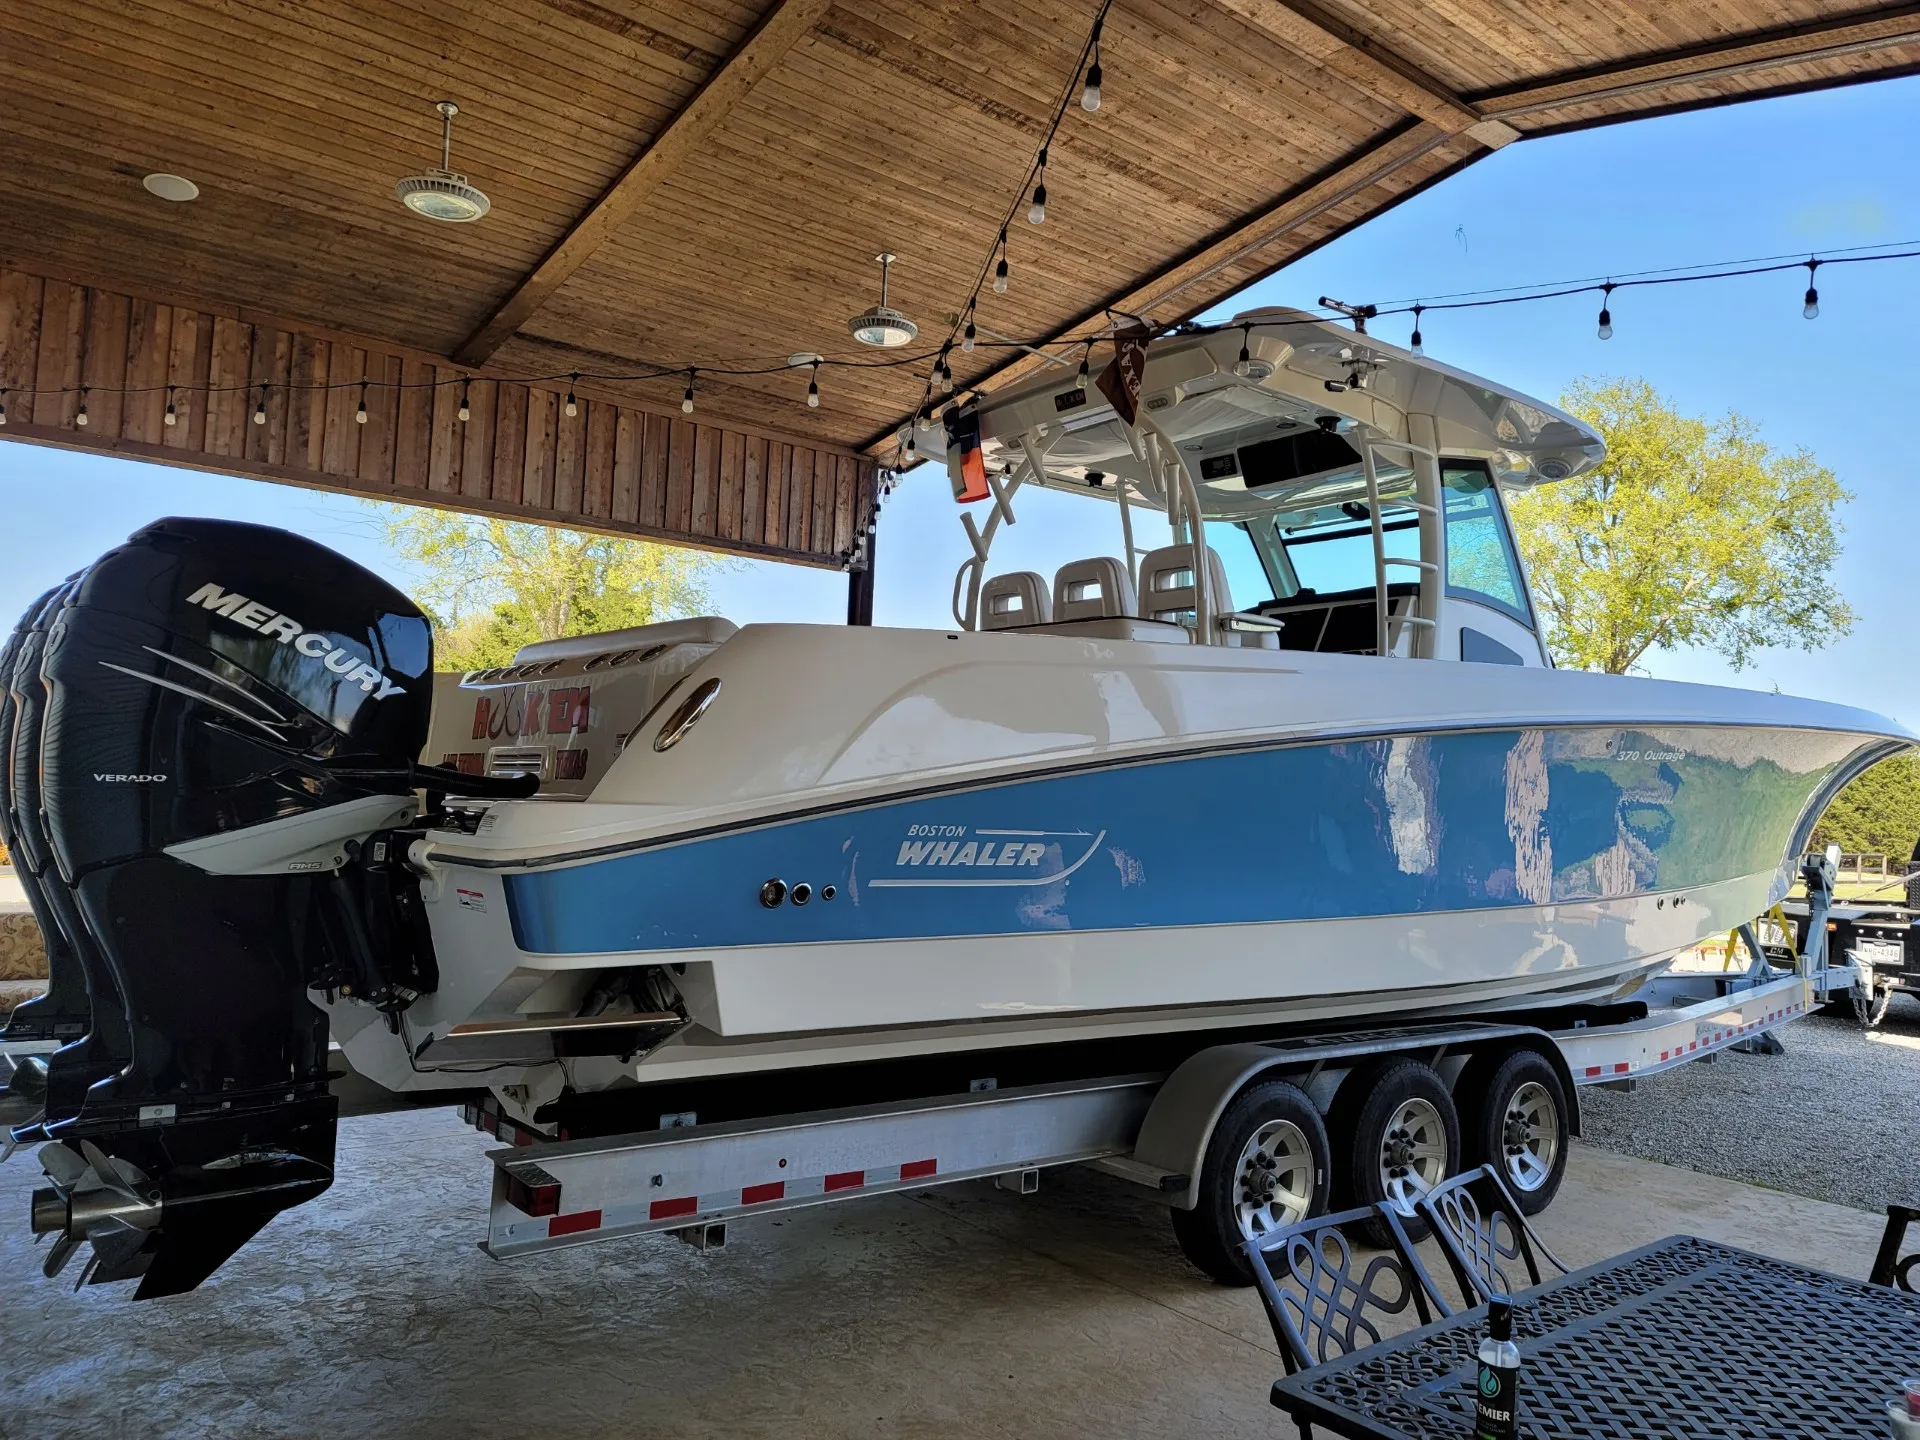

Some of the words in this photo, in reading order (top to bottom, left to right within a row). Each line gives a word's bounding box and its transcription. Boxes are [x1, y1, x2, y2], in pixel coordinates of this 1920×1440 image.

[185, 582, 407, 700] MERCURY
[1617, 751, 1640, 761] 370
[1644, 750, 1686, 762] Outrage
[93, 773, 168, 782] VERADO
[907, 824, 967, 837] BOSTON
[896, 840, 1046, 866] WHALER
